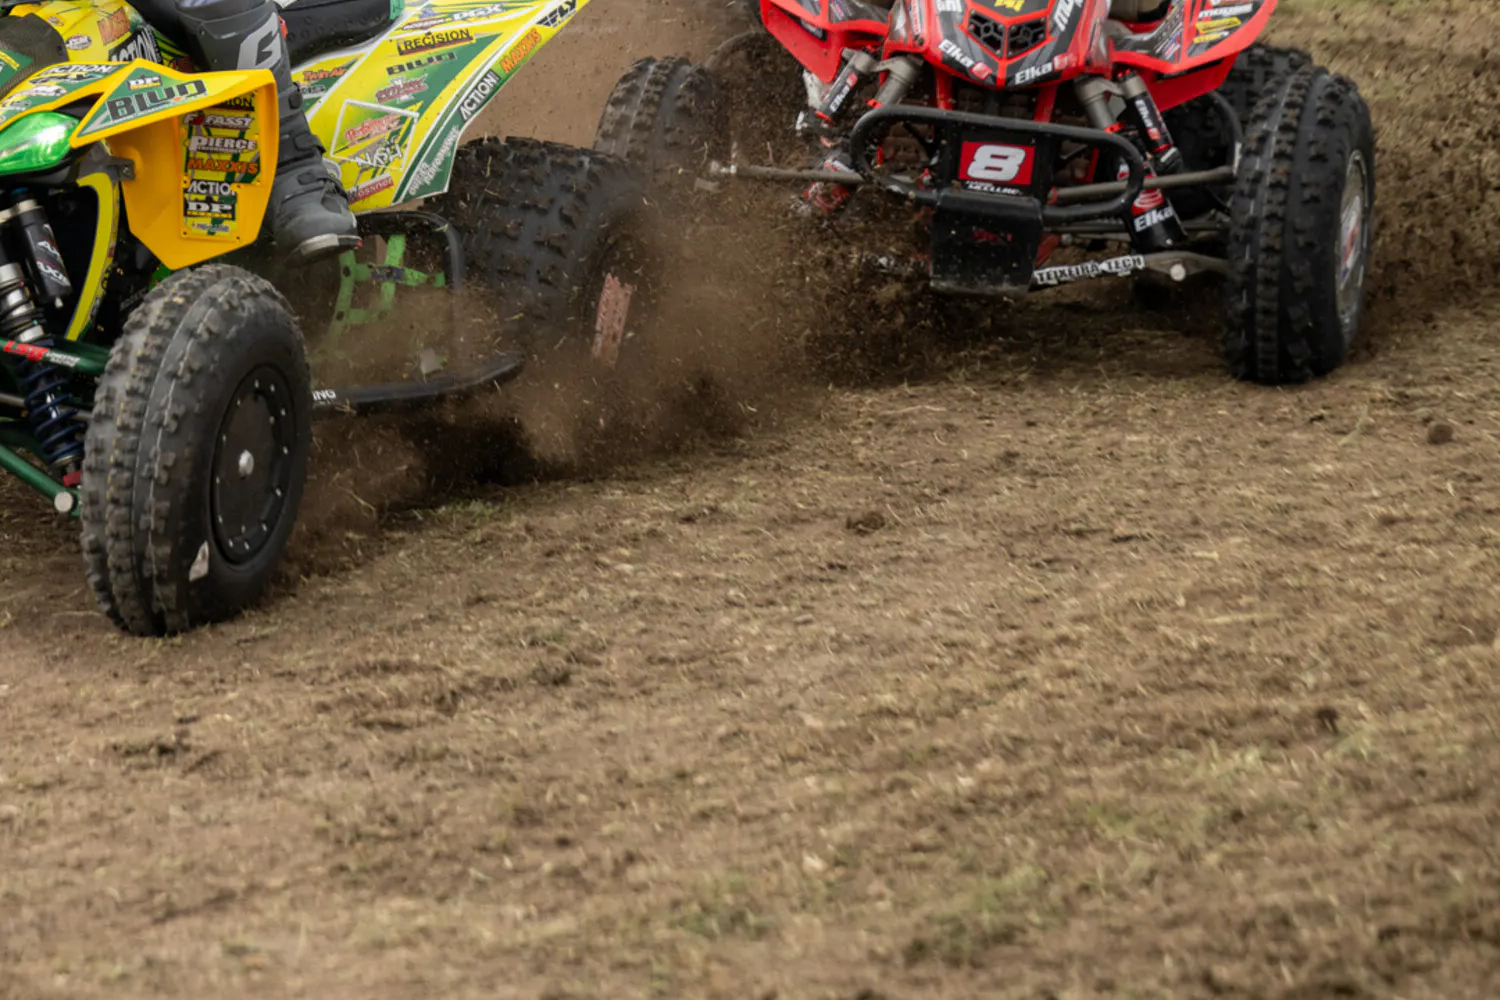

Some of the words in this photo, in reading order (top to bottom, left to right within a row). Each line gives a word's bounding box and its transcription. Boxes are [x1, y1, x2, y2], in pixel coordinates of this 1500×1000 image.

[500, 28, 542, 75] MAXXIS
[938, 39, 975, 68] Elka
[1014, 62, 1054, 85] Elka
[459, 69, 499, 122] ACTION
[829, 82, 850, 112] Elka
[1135, 99, 1152, 128] Elka
[189, 136, 258, 152] PIERCE
[187, 157, 259, 174] MAXXIS
[967, 144, 1026, 182] 8
[188, 180, 237, 196] ACTIO
[1134, 208, 1174, 233] Elka
[1037, 262, 1102, 286] TEIXEIRA
[1104, 255, 1145, 272] TECH
